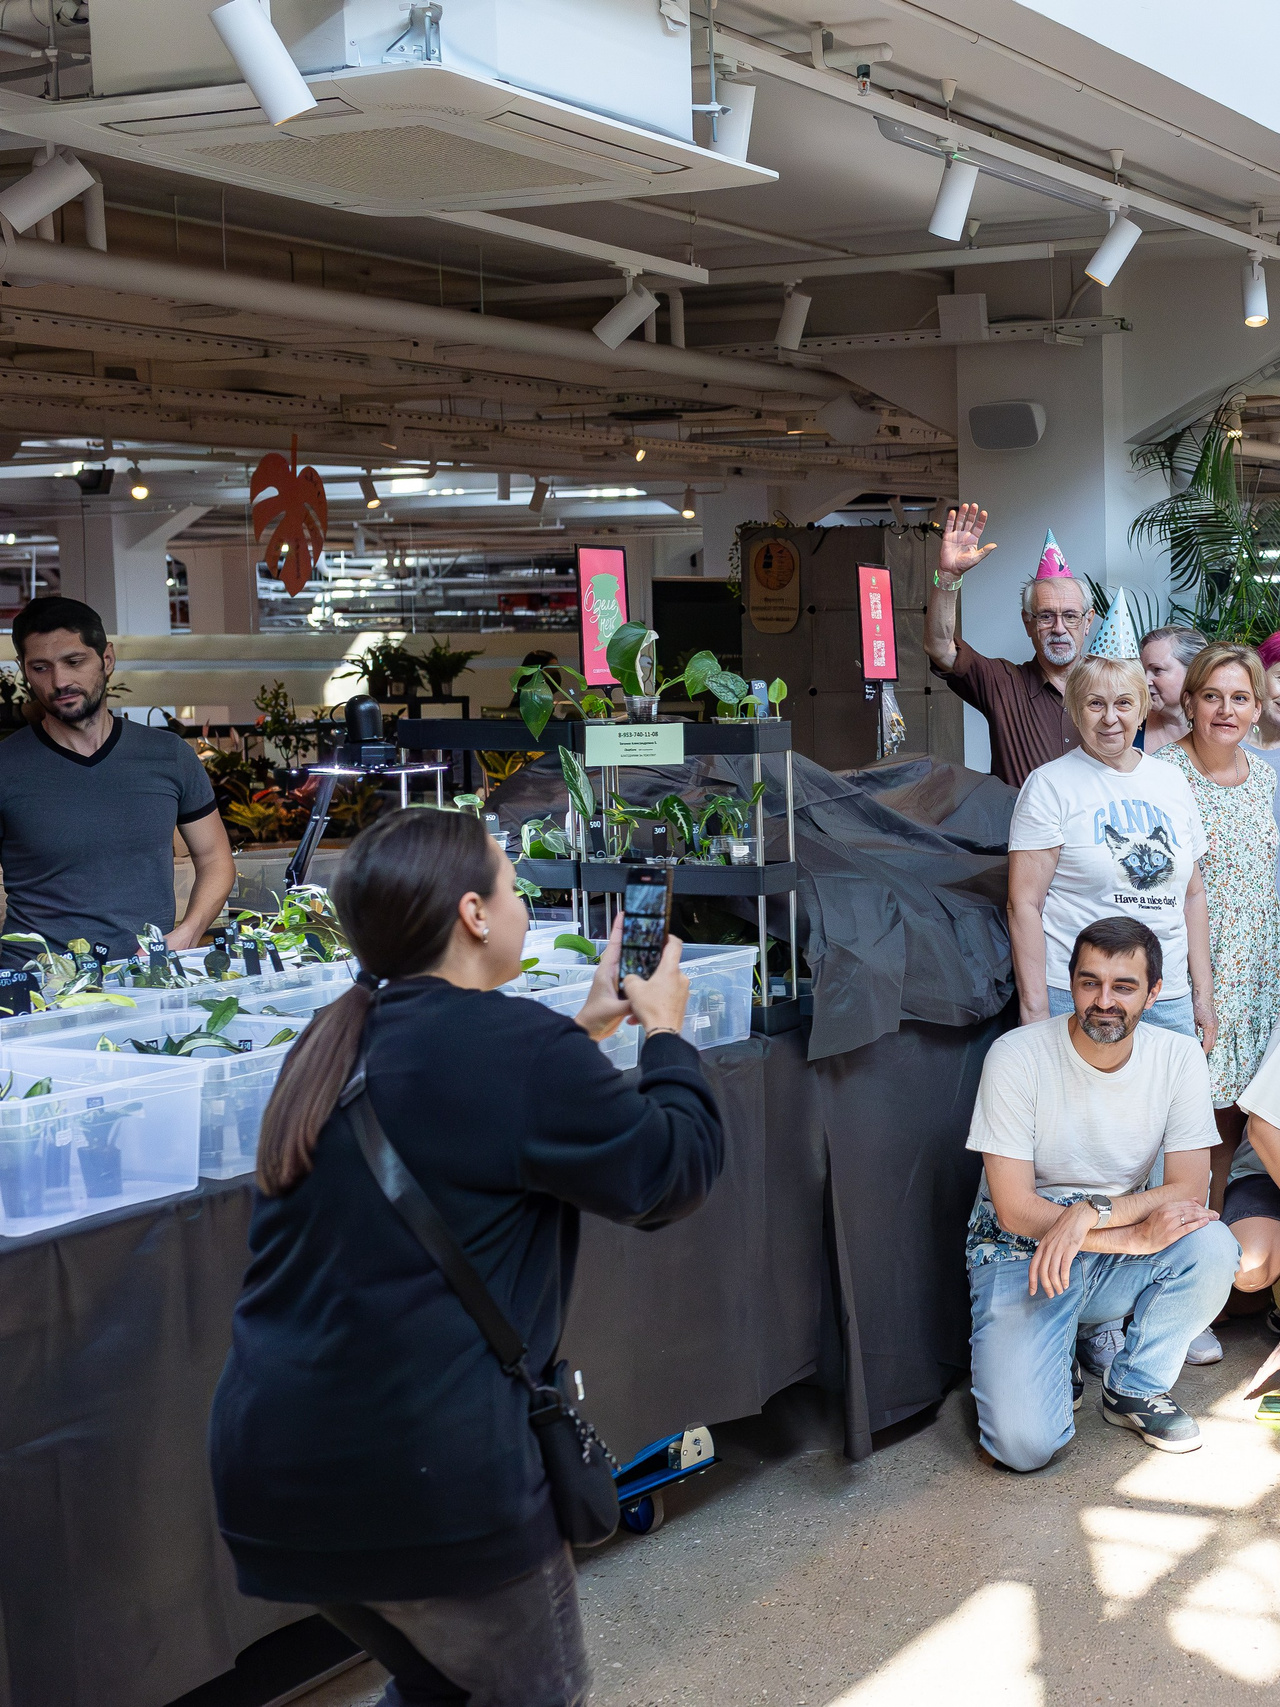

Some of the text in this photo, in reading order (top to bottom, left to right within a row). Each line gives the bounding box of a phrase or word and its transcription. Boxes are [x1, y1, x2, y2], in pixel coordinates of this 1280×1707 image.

[1094, 799, 1181, 848] GANNI
[654, 826, 666, 834] 300
[1114, 894, 1139, 904] Have
[1140, 896, 1146, 904] a
[1147, 895, 1163, 905] nice
[1163, 896, 1178, 907] day!
[150, 944, 164, 952] 400
[82, 962, 98, 970] 300
